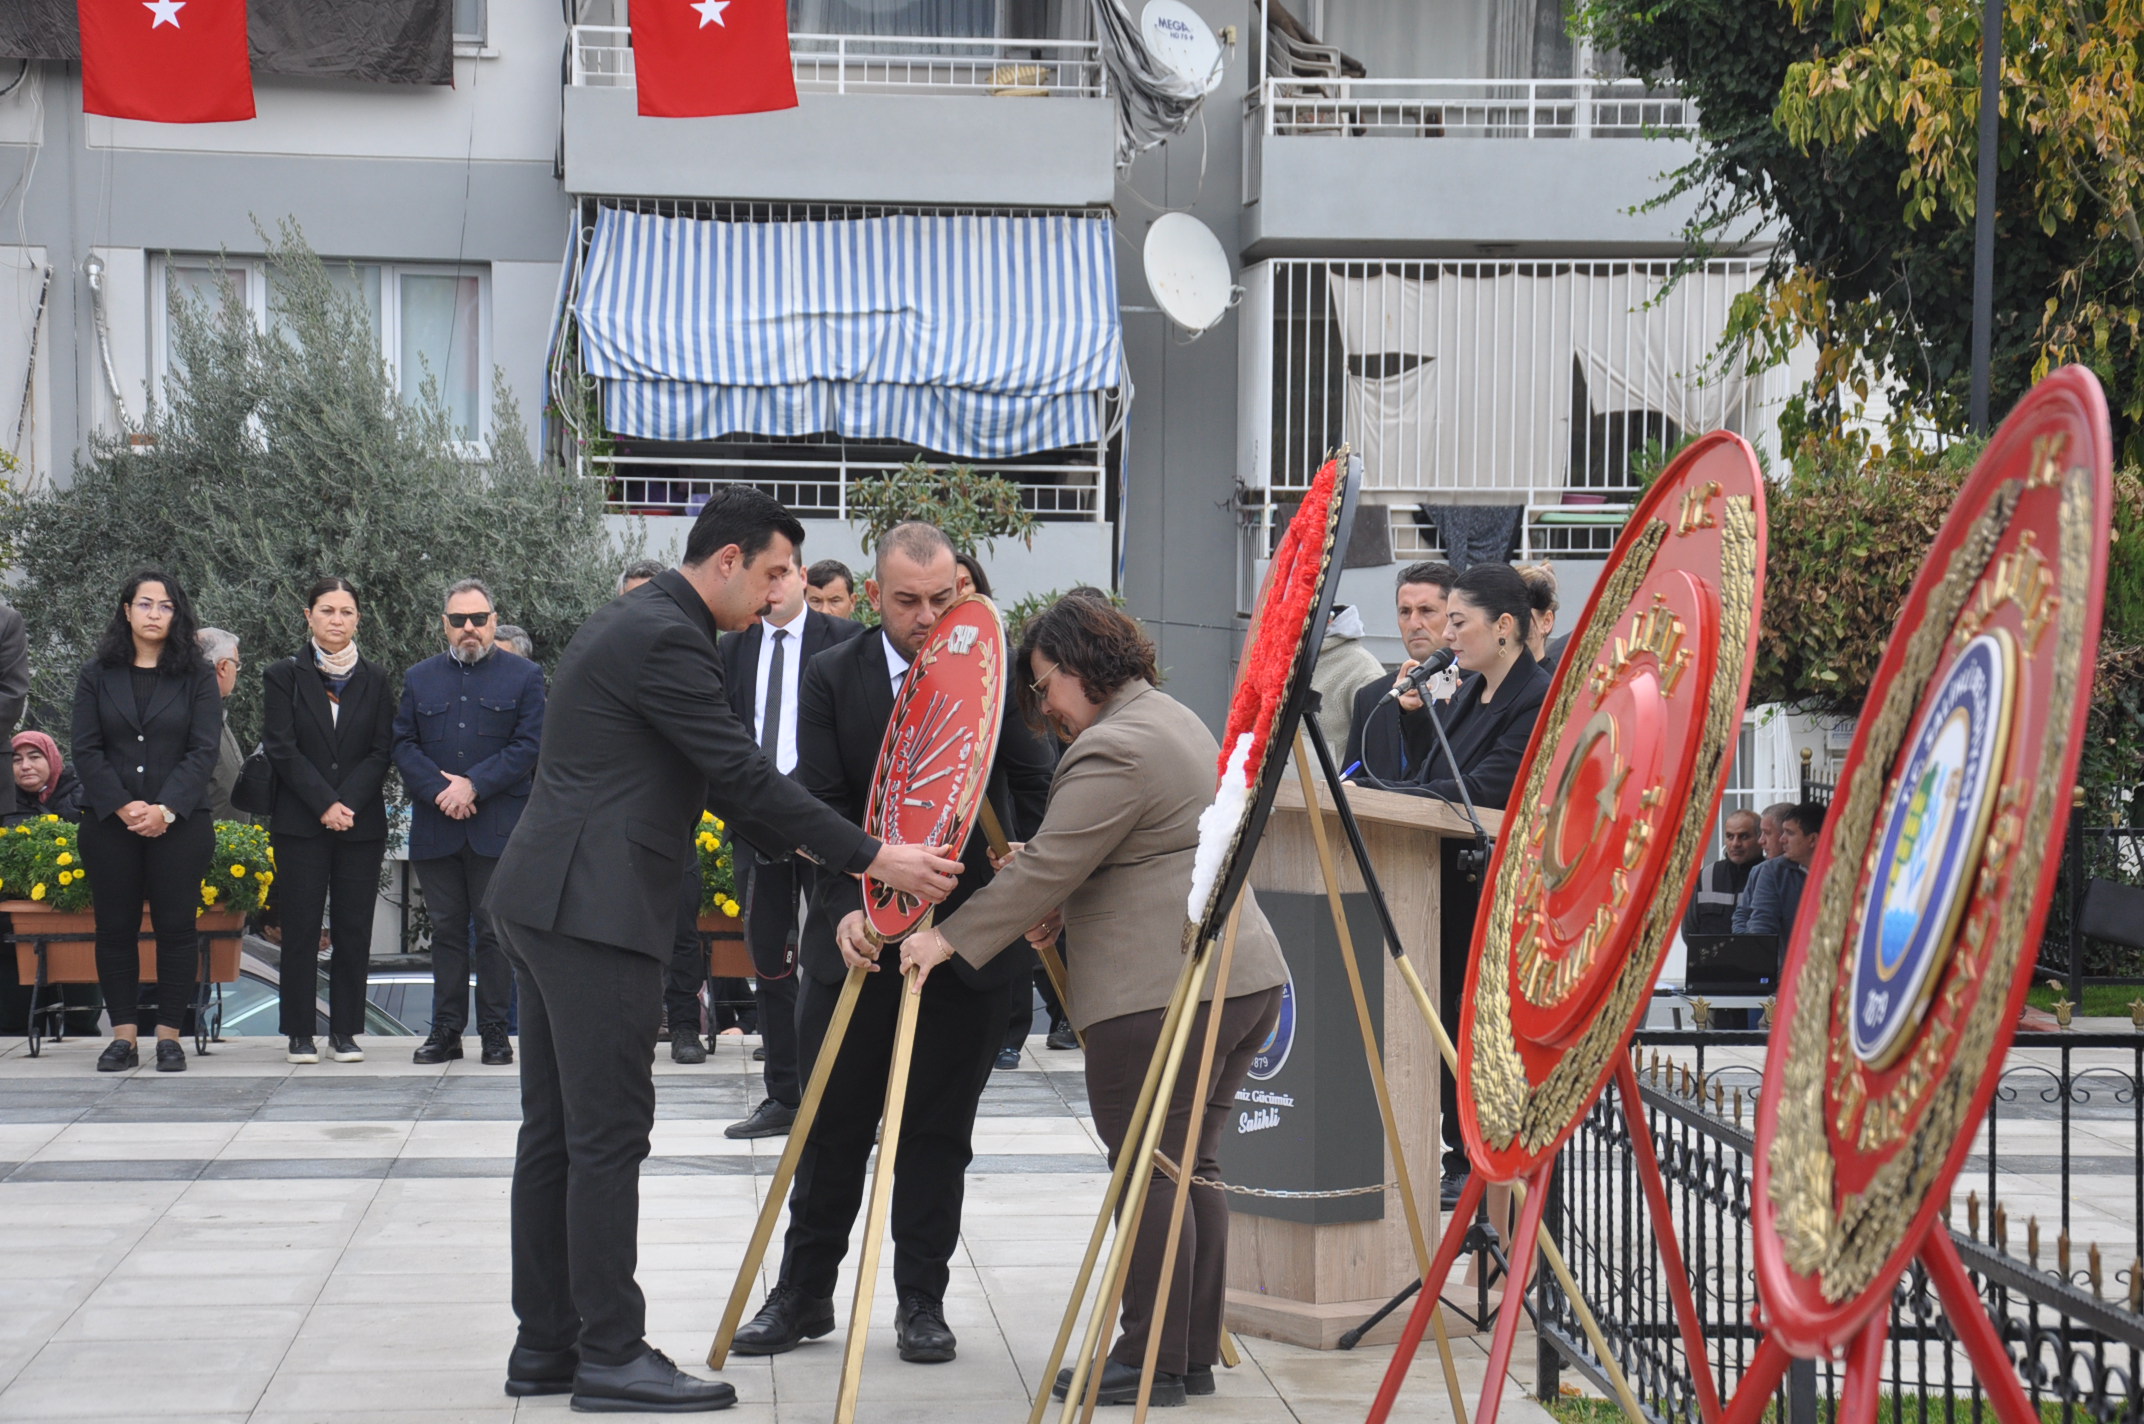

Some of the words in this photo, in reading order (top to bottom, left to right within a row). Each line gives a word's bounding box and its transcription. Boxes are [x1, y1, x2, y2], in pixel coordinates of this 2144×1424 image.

[1158, 16, 1190, 32] MEGA
[947, 624, 979, 656] CHP
[1252, 1089, 1295, 1107] Gücümüz
[1238, 1107, 1280, 1133] Salihli
